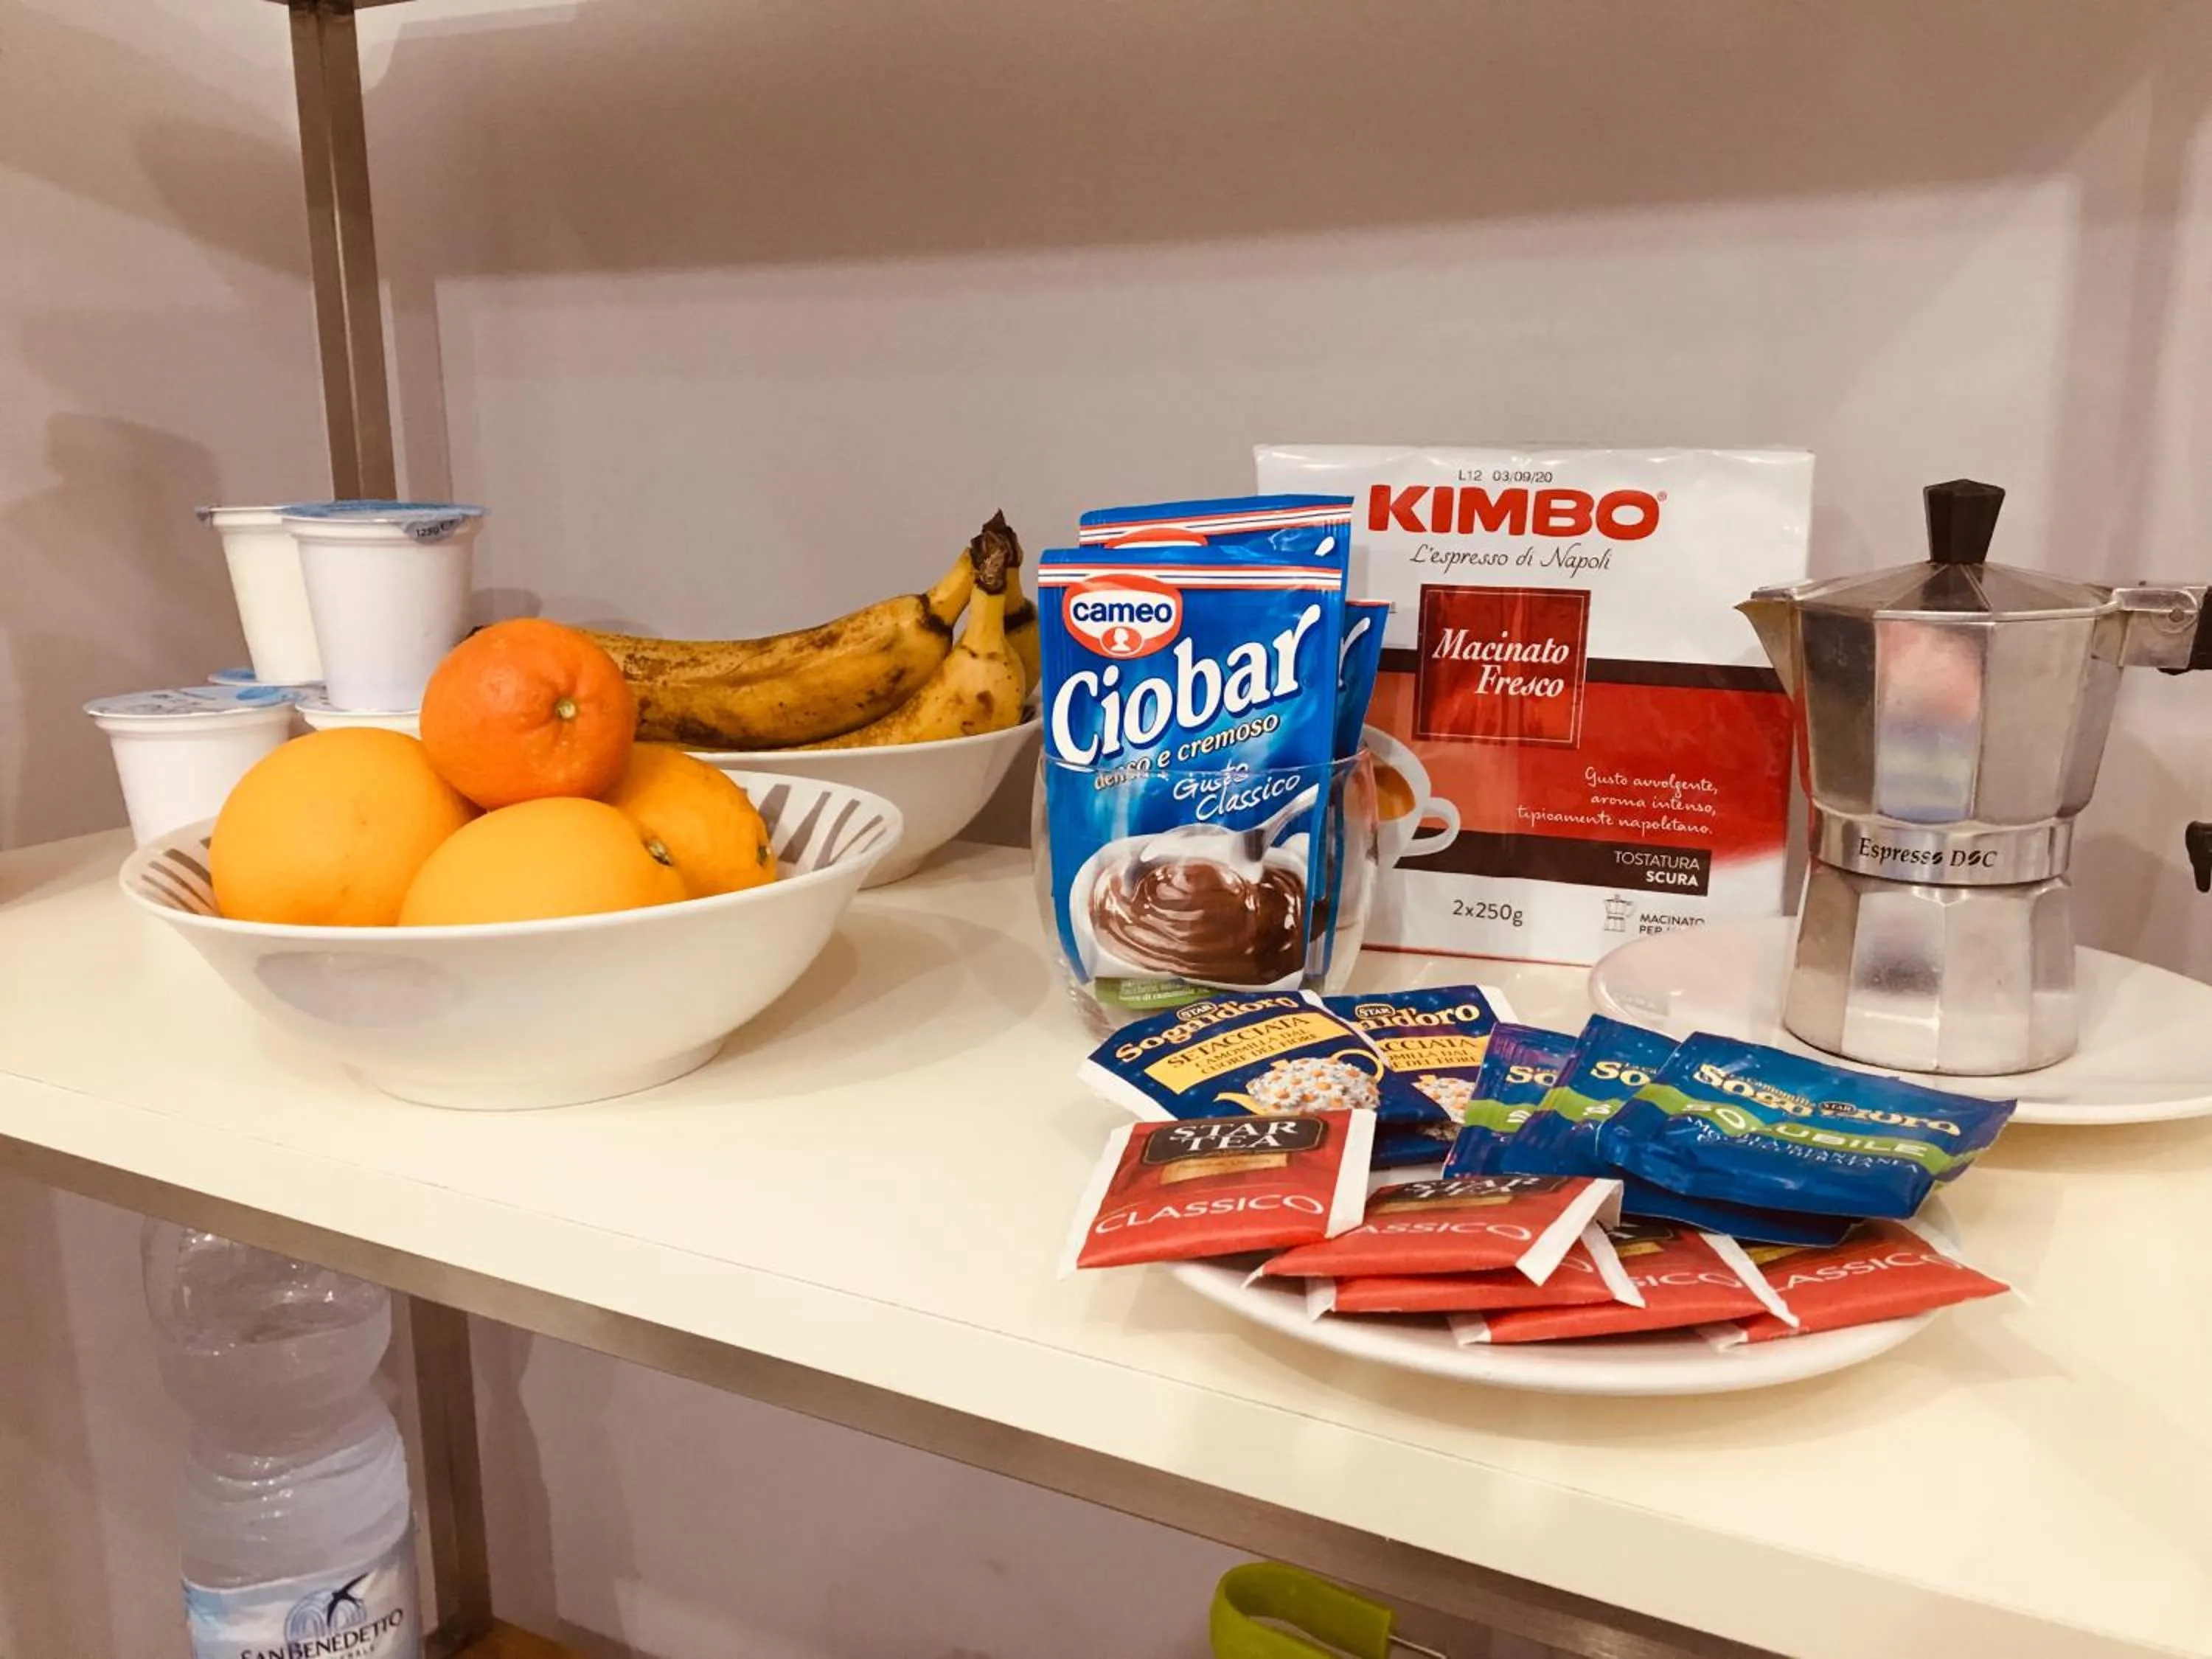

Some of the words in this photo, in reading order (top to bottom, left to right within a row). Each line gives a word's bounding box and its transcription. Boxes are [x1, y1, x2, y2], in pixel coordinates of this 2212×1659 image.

[1457, 469, 1483, 481] L12
[1492, 470, 1554, 484] 03/09/20
[1368, 484, 1660, 541] KIMBO
[1409, 543, 1509, 574] L'espresso
[1515, 546, 1534, 567] di
[1540, 542, 1613, 579] Napoli
[1072, 599, 1173, 624] cameo
[1431, 627, 1570, 664] Macinato
[1051, 603, 1321, 765] Ciobar
[1475, 664, 1565, 698] Fresco
[1157, 750, 1172, 768] e
[1177, 713, 1281, 762] cremoso
[1585, 766, 1629, 788] Gusto
[1632, 773, 1718, 799] avvolgente,
[1194, 774, 1301, 822] Classico
[1590, 795, 1646, 809] aroma
[1652, 796, 1717, 817] intenso,
[1515, 804, 1614, 828] tipicamente
[1618, 815, 1714, 838] napoletano.
[1613, 850, 1700, 871] TOSTATURA
[1858, 837, 1944, 866] Espresso
[1645, 870, 1699, 887] SCURA
[1452, 899, 1525, 927] 2x250g
[1180, 1004, 1213, 1020] STAR
[1359, 1006, 1391, 1018] STAR
[1167, 1014, 1310, 1069] SETACCIATA
[1194, 1036, 1279, 1068] CAMOMILLA
[1169, 1133, 1281, 1152] TEA
[1172, 1121, 1298, 1138] STAR
[1094, 1194, 1325, 1234] CLASSICO
[1346, 1222, 1532, 1241] ASSICO
